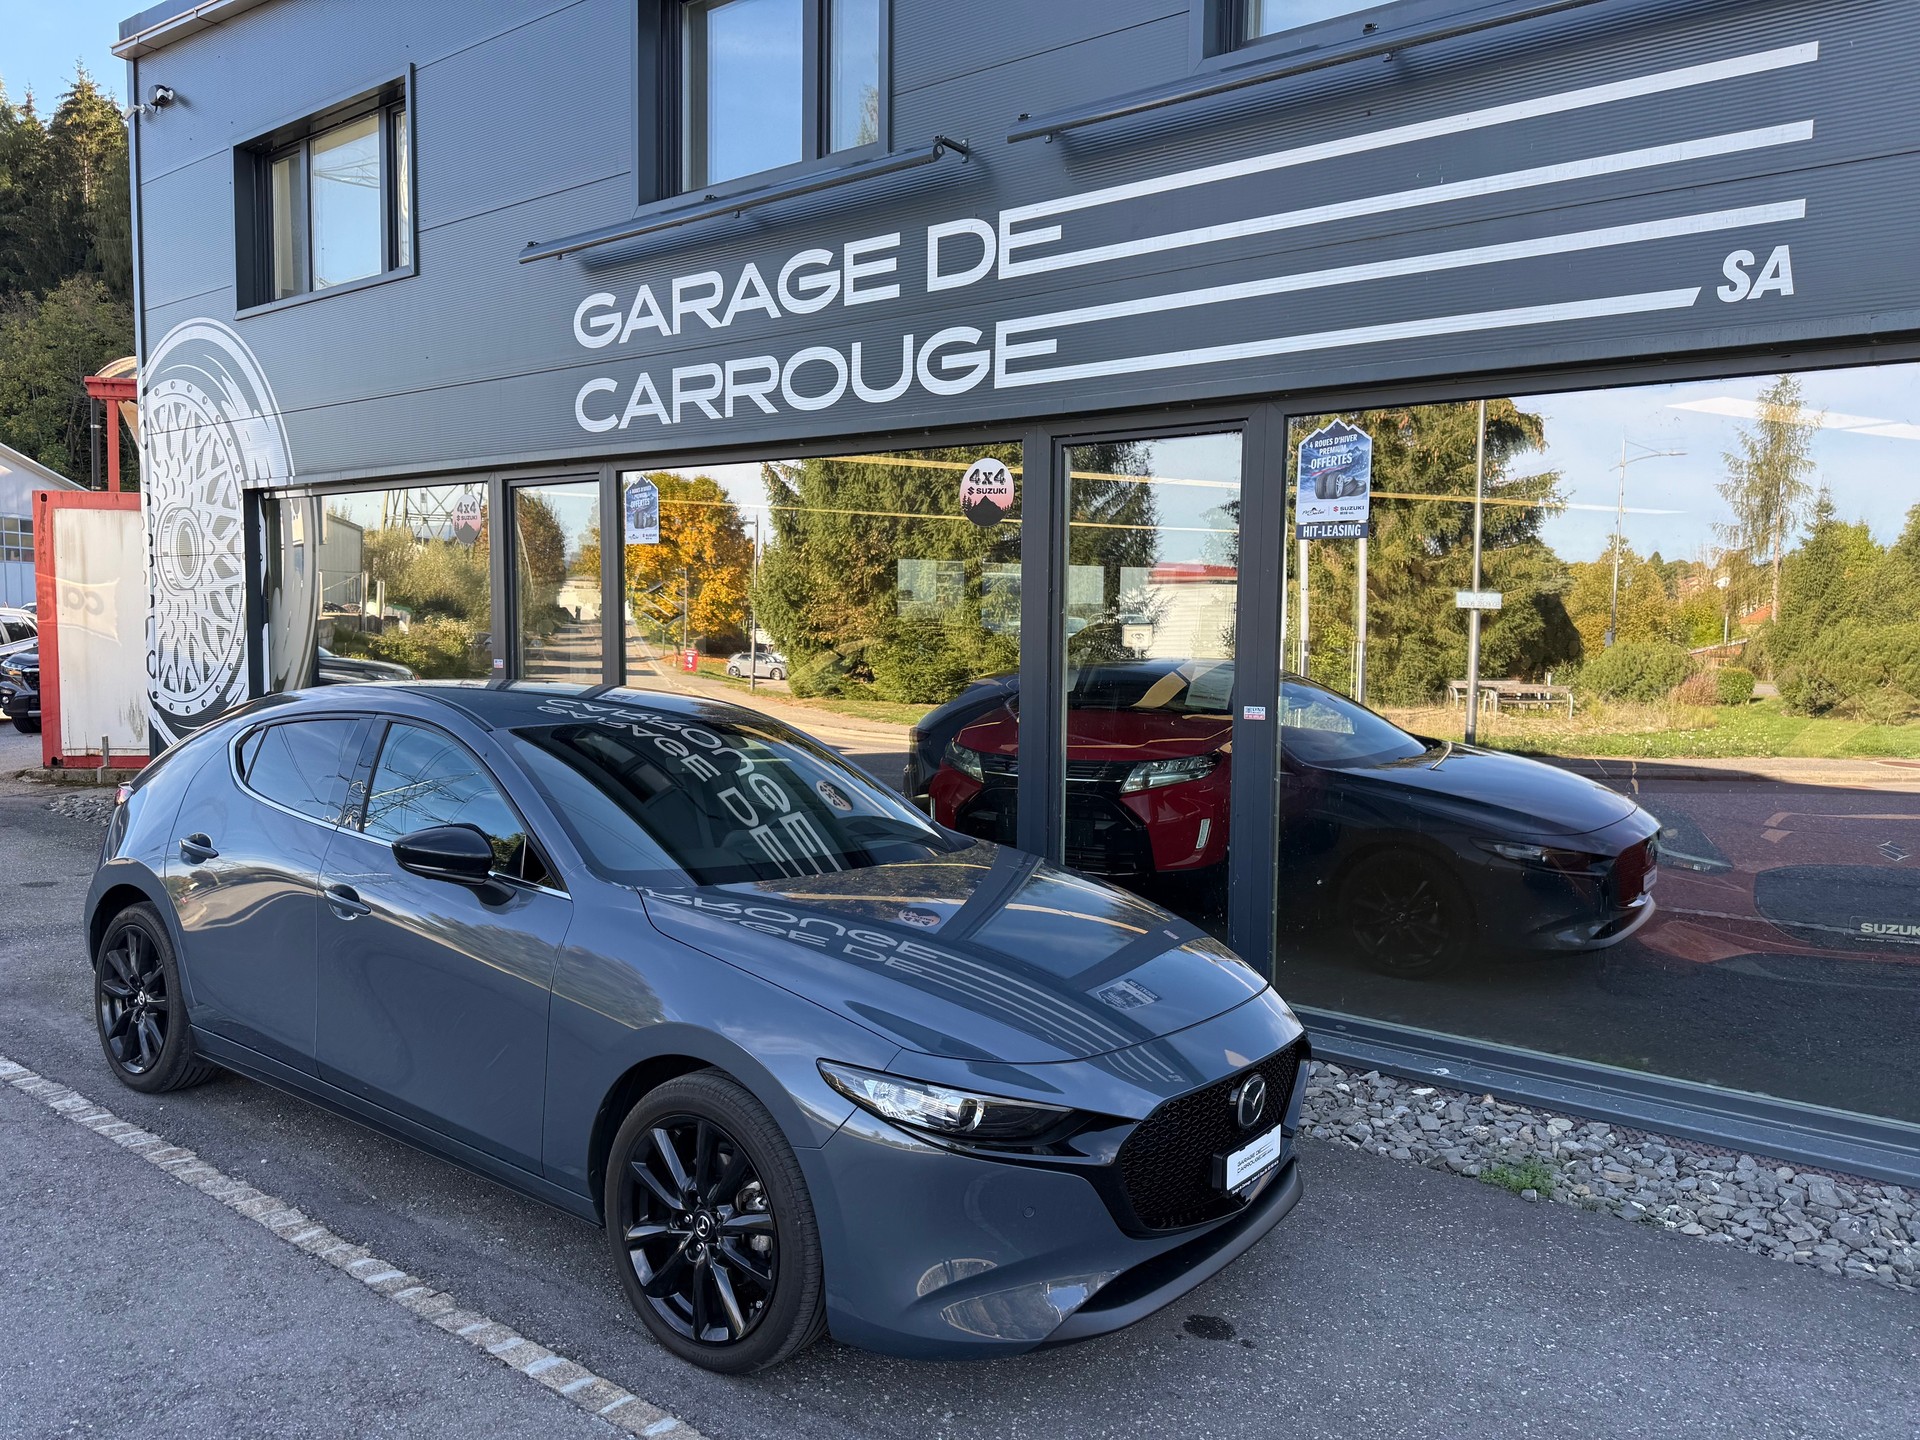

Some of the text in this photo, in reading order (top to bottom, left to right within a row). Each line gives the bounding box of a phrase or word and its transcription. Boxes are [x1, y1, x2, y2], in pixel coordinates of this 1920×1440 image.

[573, 199, 1062, 349] GARAGE DE
[1717, 245, 1794, 303] SA
[574, 314, 1058, 433] CARROUGE
[1314, 438, 1333, 449] ROUES
[1334, 434, 1358, 445] D'HIVER
[1319, 444, 1347, 456] PREMIUM
[1310, 452, 1353, 470] OFFERTES
[969, 468, 1006, 485] 4x4
[976, 487, 1007, 495] SUZUKI
[457, 501, 477, 514] 4x4
[1303, 524, 1362, 538] HIT-LEASING
